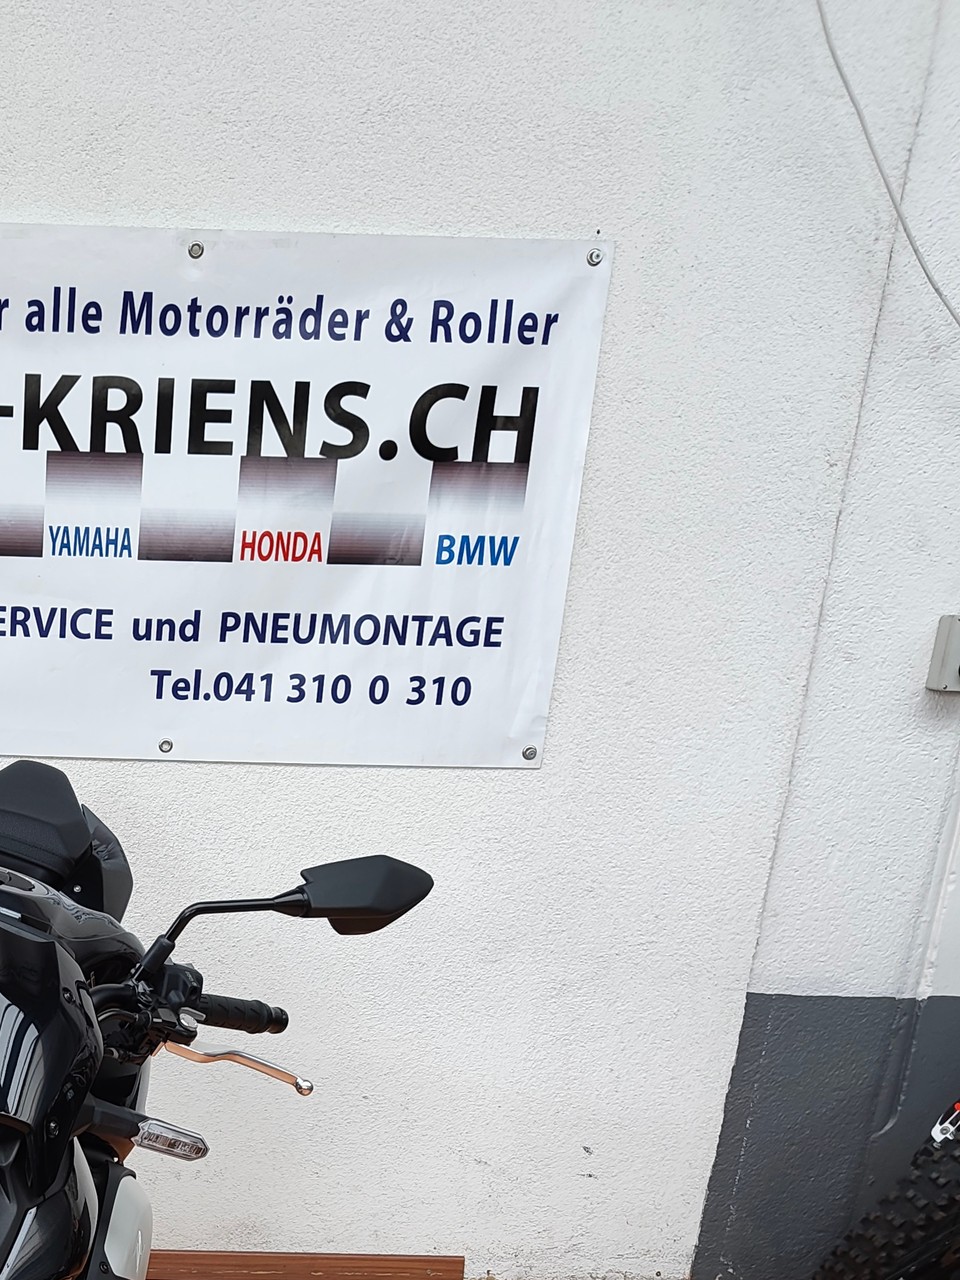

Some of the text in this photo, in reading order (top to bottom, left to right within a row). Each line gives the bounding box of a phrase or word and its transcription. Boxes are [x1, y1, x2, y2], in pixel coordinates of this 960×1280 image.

[24, 286, 103, 335] alle
[119, 290, 370, 342] Motorräder
[384, 298, 414, 343] &
[429, 298, 560, 346] Roller
[48, 526, 133, 559] YAMAHA
[239, 530, 324, 563] HONDA
[434, 533, 520, 568] BMW
[132, 609, 202, 643] und
[219, 611, 506, 648] PNEUMONTAGE
[286, 673, 352, 705] 310
[368, 674, 390, 705] 0
[405, 675, 472, 707] 310
